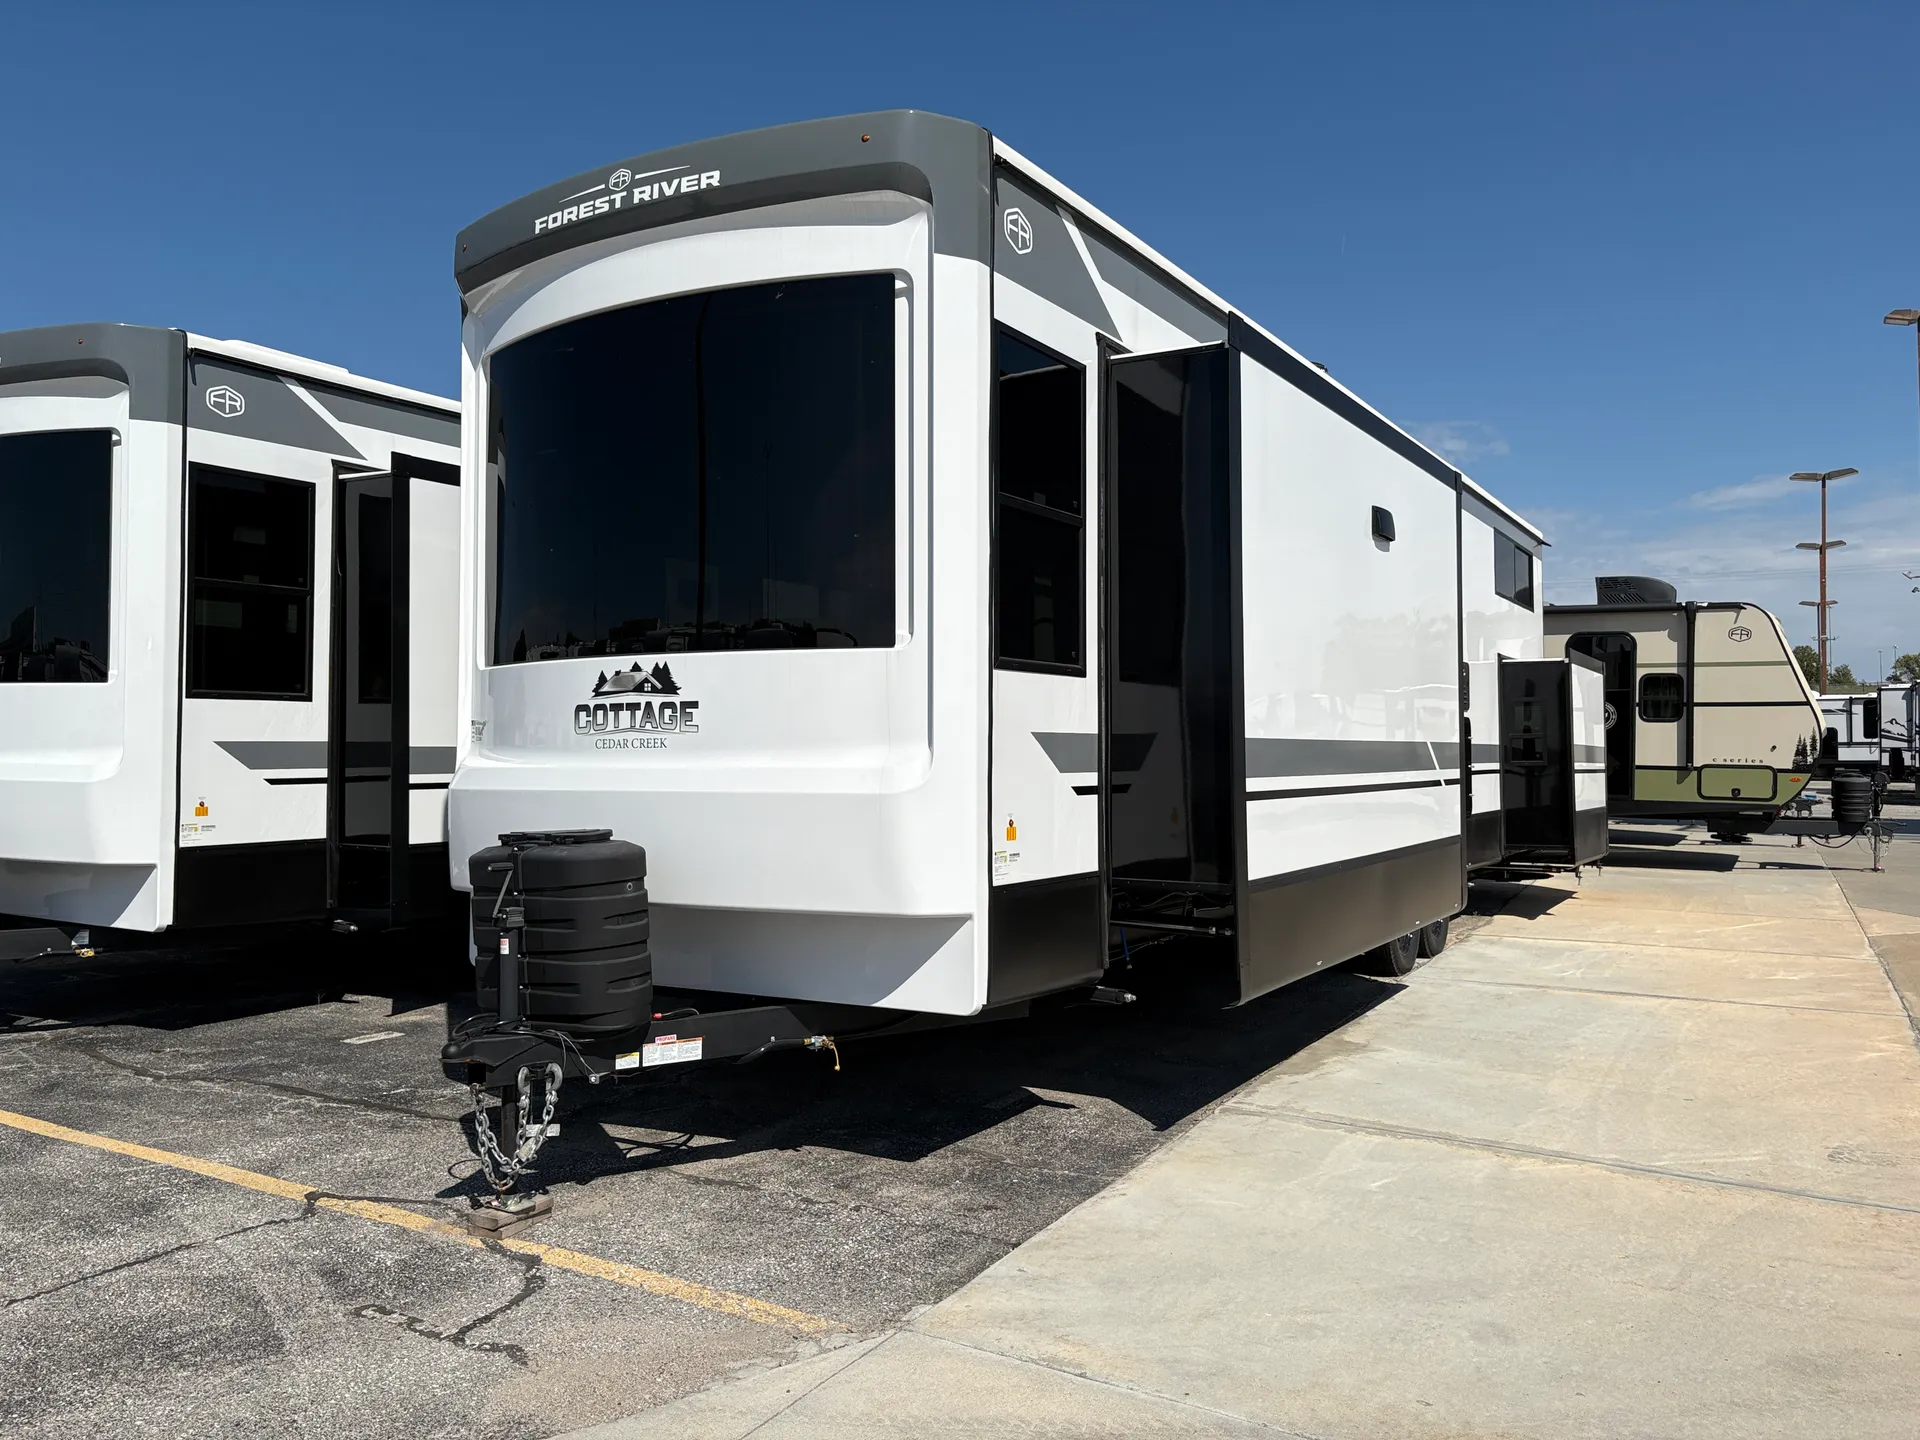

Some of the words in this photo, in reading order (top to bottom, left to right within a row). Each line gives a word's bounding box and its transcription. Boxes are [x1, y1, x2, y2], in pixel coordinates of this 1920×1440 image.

[534, 191, 628, 235] FOREST
[633, 169, 721, 204] RIVER
[1007, 214, 1030, 249] FR
[210, 389, 241, 414] FR
[574, 700, 699, 735] COTTAGE
[595, 738, 629, 750] CEDAR
[631, 737, 668, 749] CREEK
